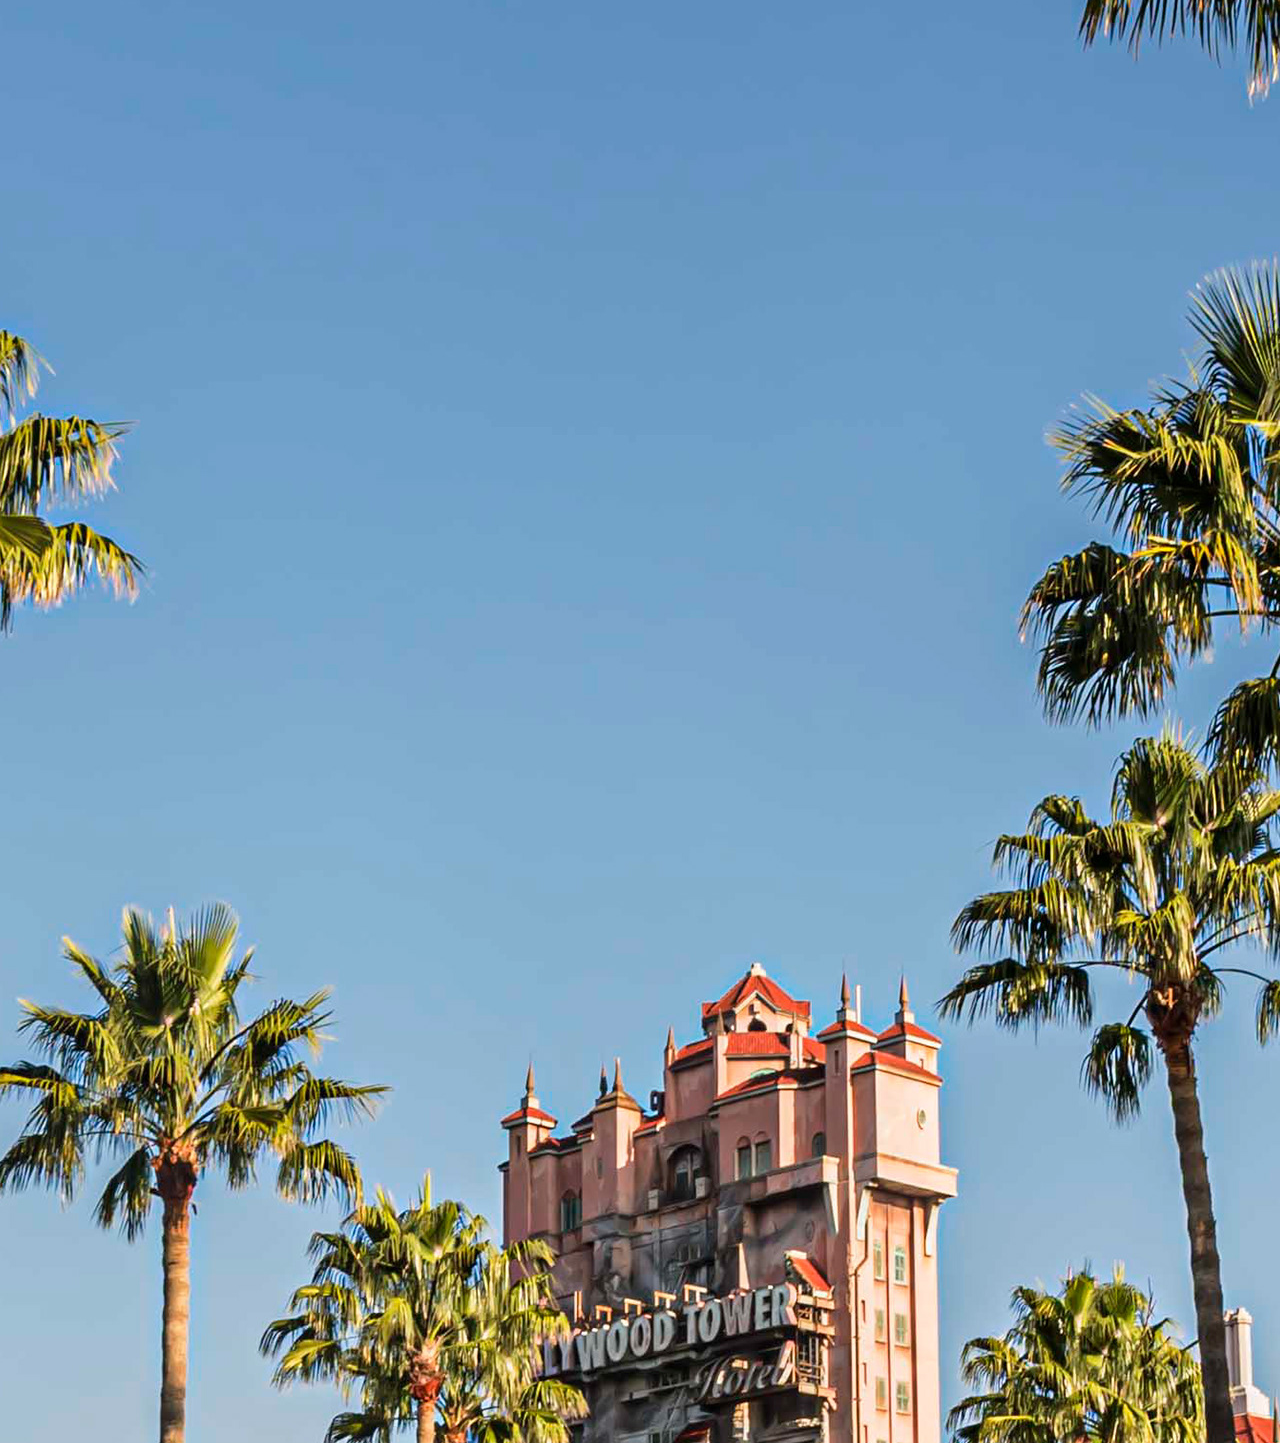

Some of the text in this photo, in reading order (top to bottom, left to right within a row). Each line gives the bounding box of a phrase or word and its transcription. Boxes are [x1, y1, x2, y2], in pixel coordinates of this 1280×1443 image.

[543, 1281, 799, 1378] LYWOOD TOWER
[692, 1339, 797, 1399] Hotel
